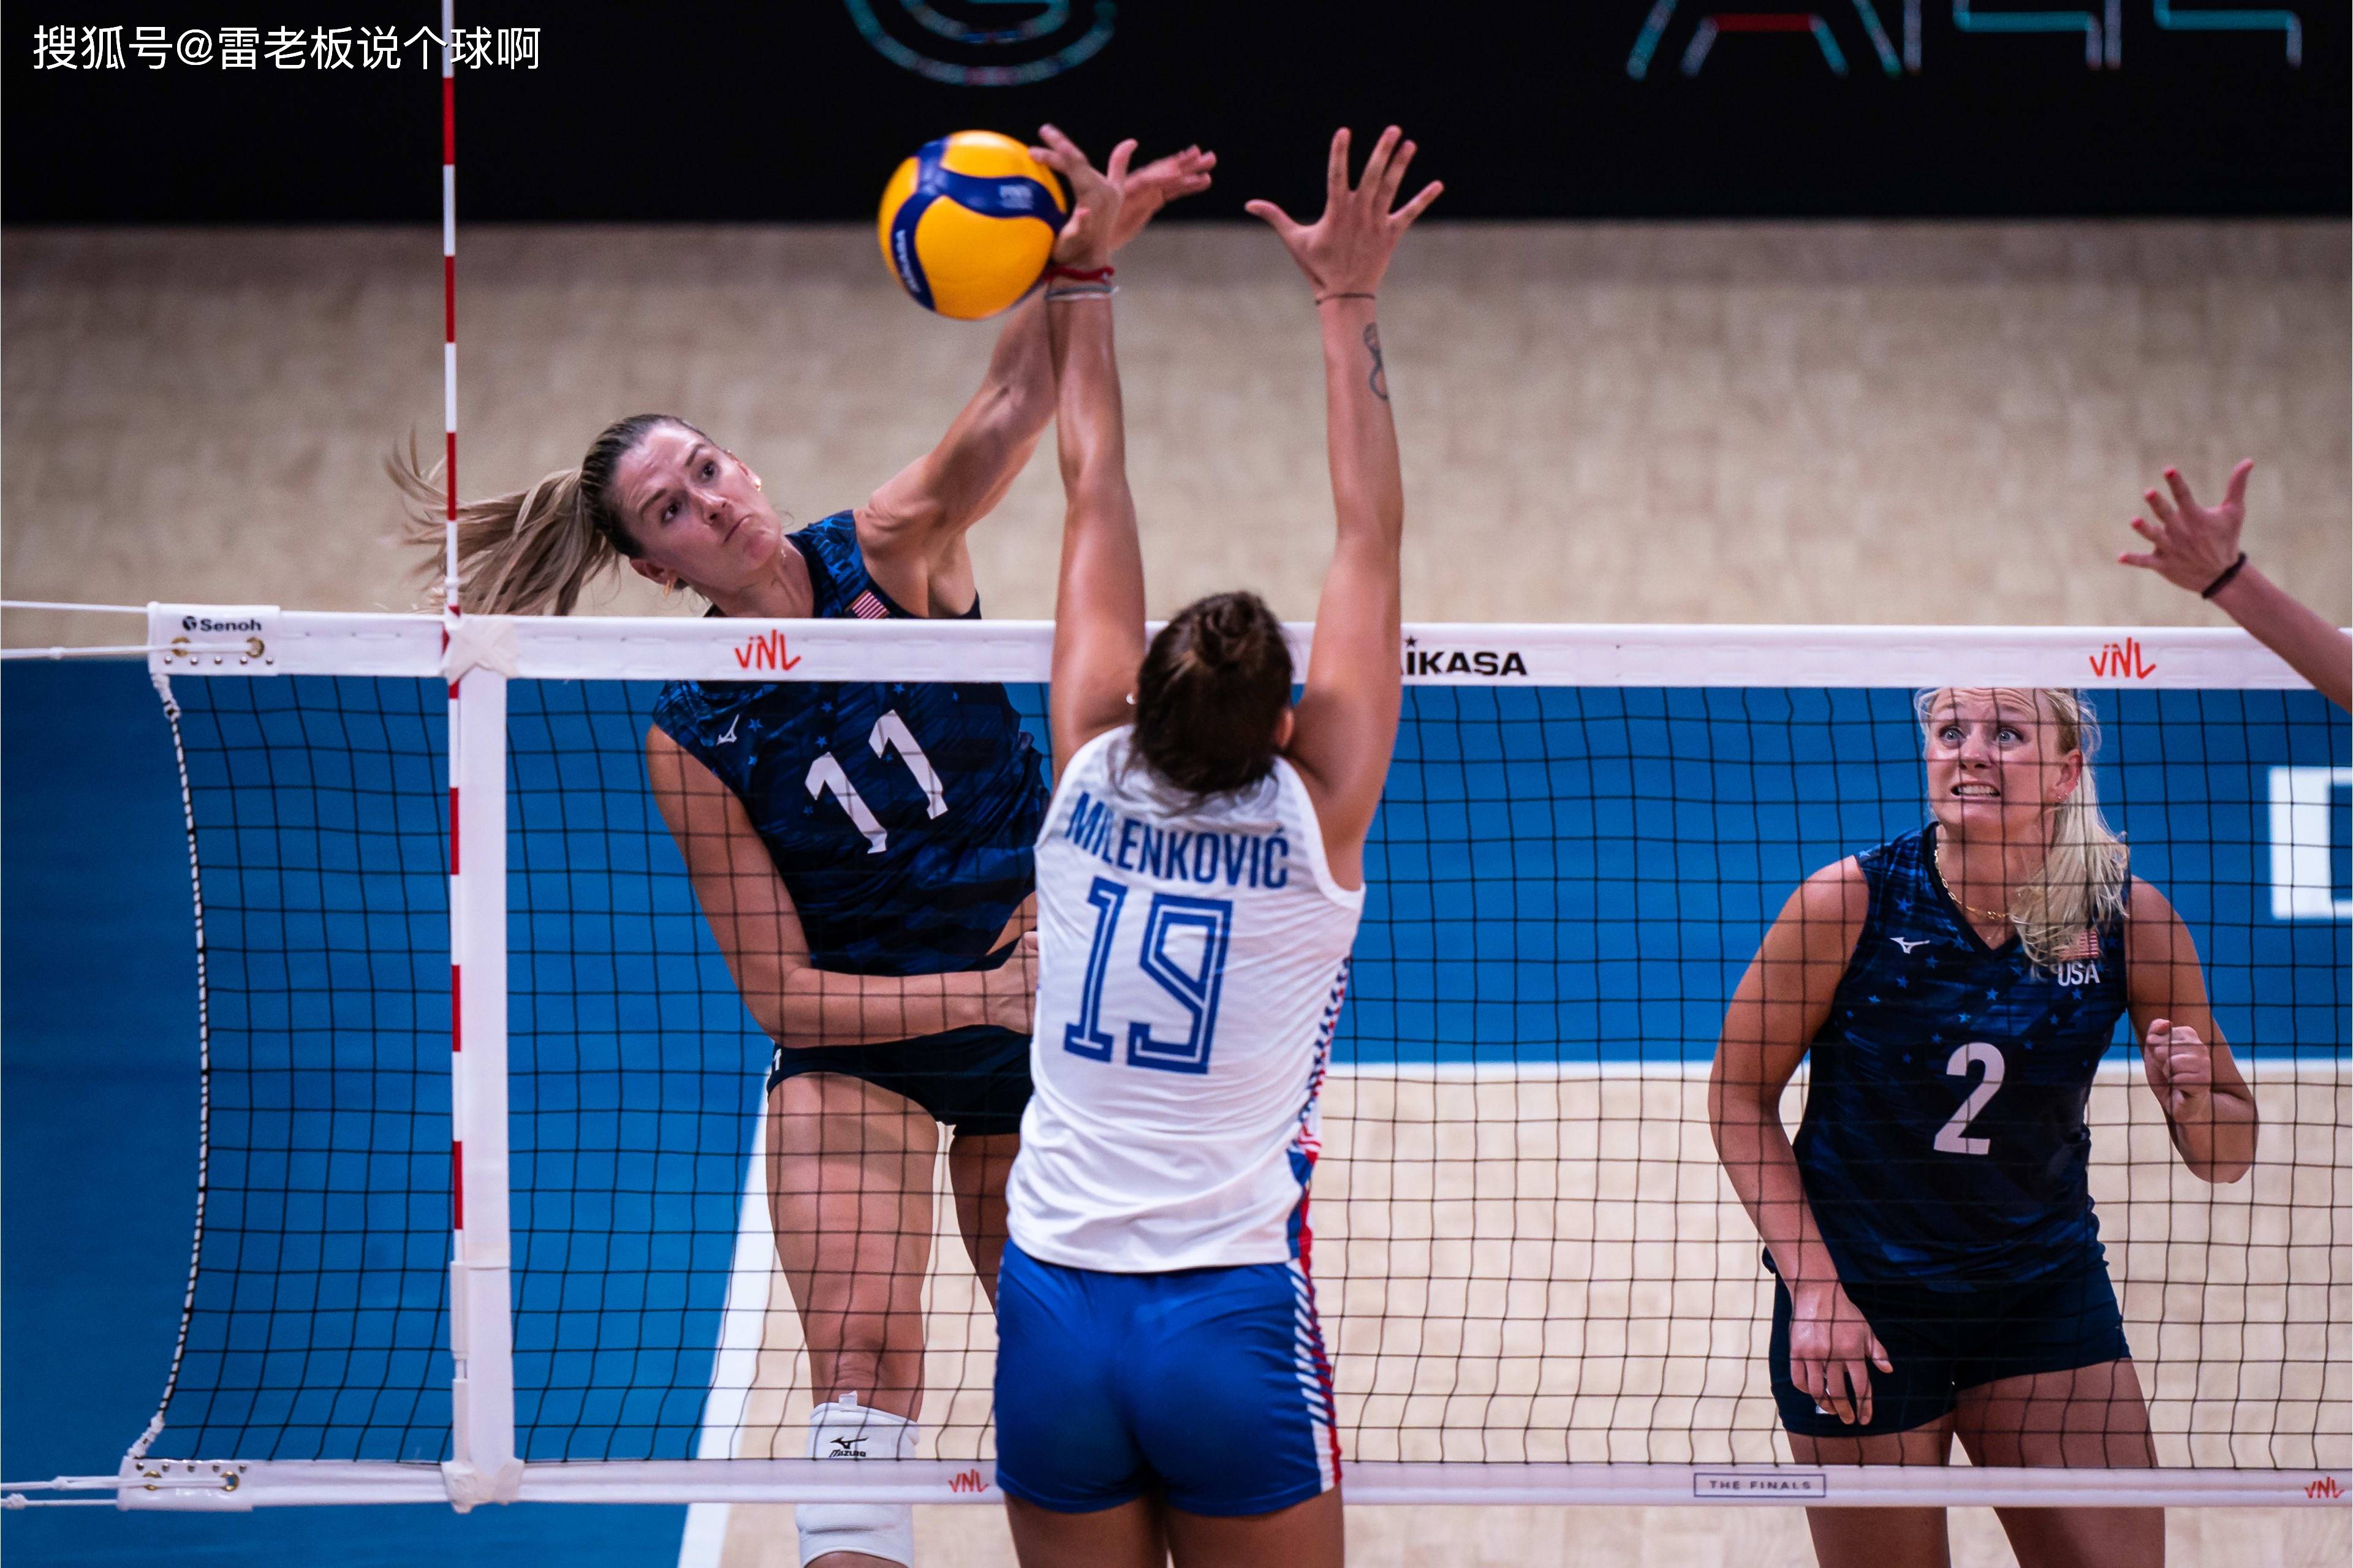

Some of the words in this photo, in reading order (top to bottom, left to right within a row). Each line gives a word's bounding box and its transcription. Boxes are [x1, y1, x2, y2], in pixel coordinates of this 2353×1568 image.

[200, 618, 262, 632] Senoh
[1401, 635, 1528, 676] IKASA
[805, 709, 949, 854] 11
[1063, 876, 1233, 1075] 19
[2058, 960, 2101, 987] USA
[1933, 1042, 2005, 1155] 2
[1709, 1480, 1740, 1490] THE
[1750, 1480, 1811, 1490] FINALS
